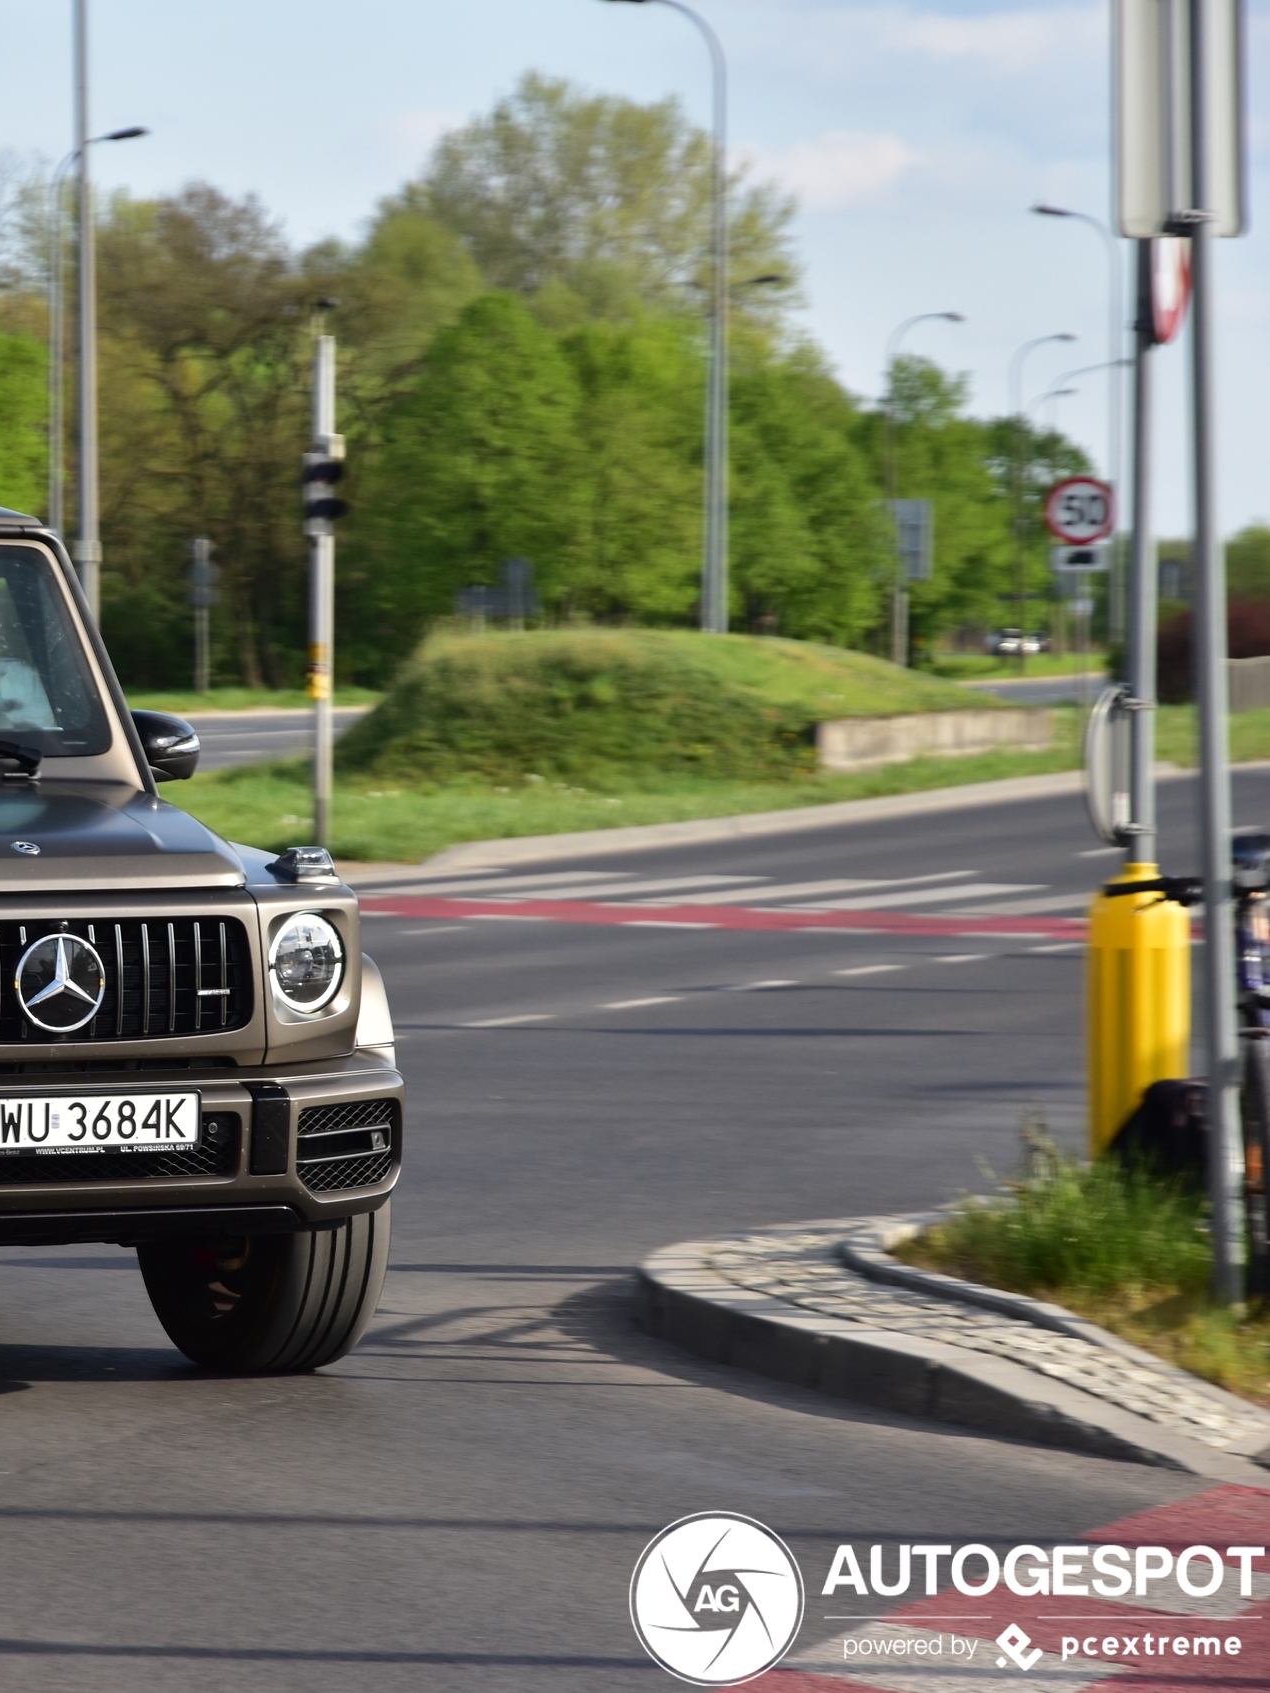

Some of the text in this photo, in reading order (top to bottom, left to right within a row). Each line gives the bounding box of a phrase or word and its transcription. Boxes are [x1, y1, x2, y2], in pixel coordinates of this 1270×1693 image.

[1063, 495, 1109, 526] 50
[0, 1097, 187, 1143] WU 3684K
